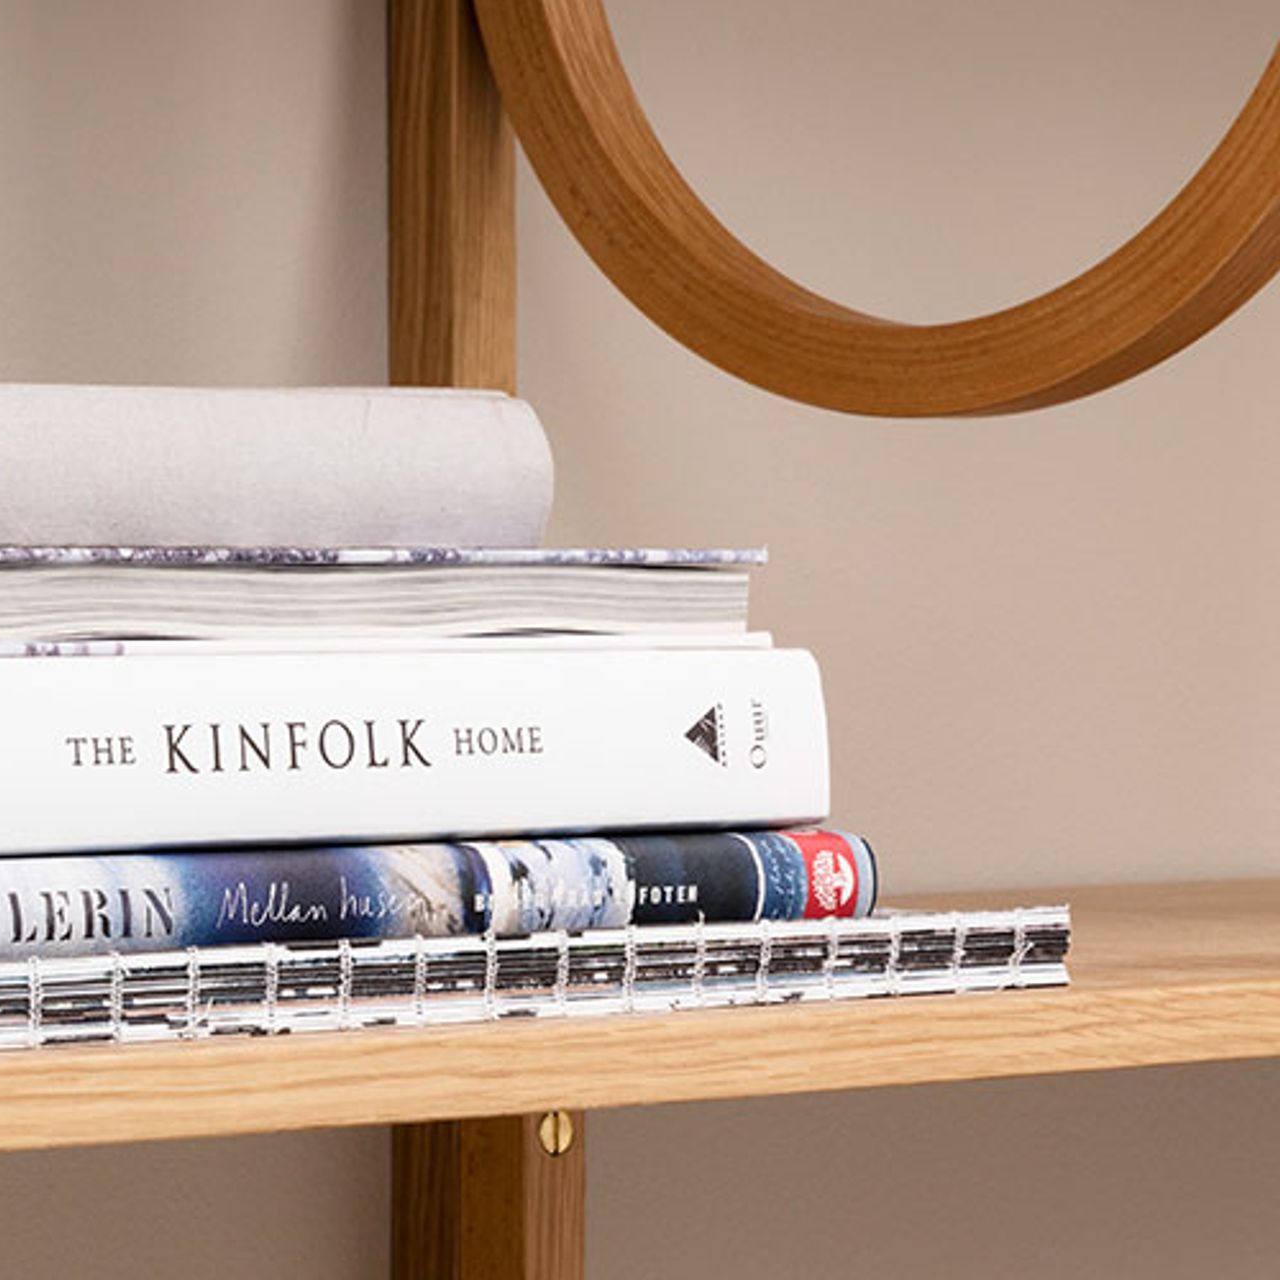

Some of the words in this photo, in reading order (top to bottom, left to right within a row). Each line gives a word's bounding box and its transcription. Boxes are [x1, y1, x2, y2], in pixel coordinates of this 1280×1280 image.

[66, 736, 136, 767] THE
[162, 719, 433, 774] KINFOLK
[452, 726, 545, 756] HOME
[8, 887, 173, 944] LERIN
[215, 881, 328, 929] Mellan
